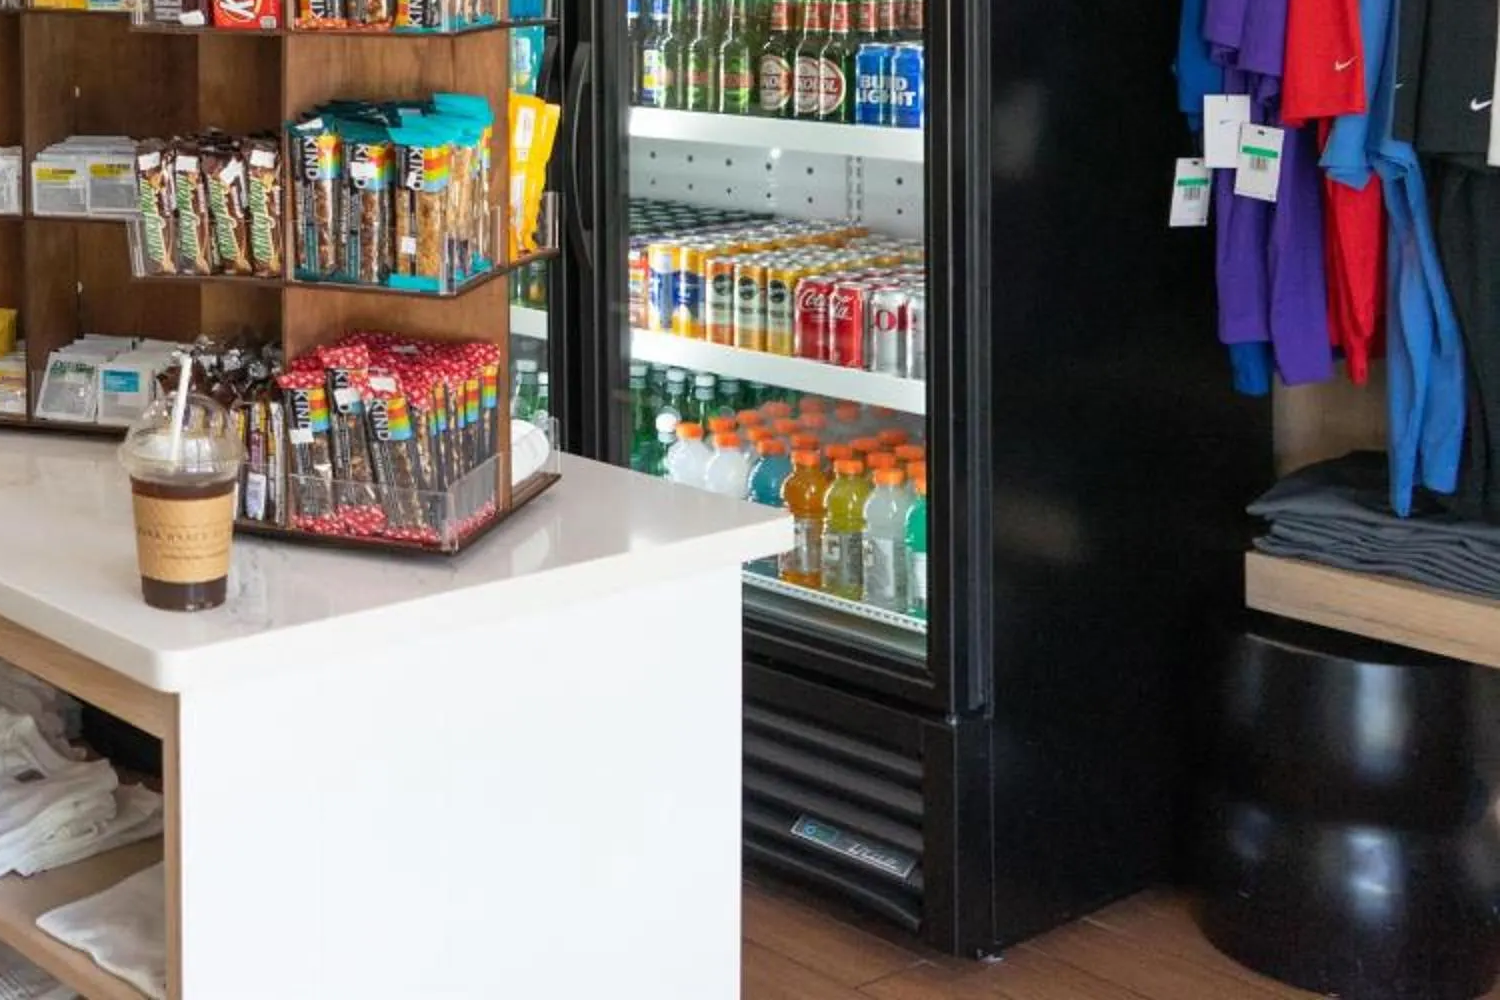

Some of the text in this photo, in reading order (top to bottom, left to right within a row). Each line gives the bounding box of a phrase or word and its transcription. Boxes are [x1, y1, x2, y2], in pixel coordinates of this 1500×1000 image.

[303, 135, 320, 180] KIND
[354, 143, 370, 190] KID
[335, 368, 349, 413] KID
[372, 399, 392, 441] KIND
